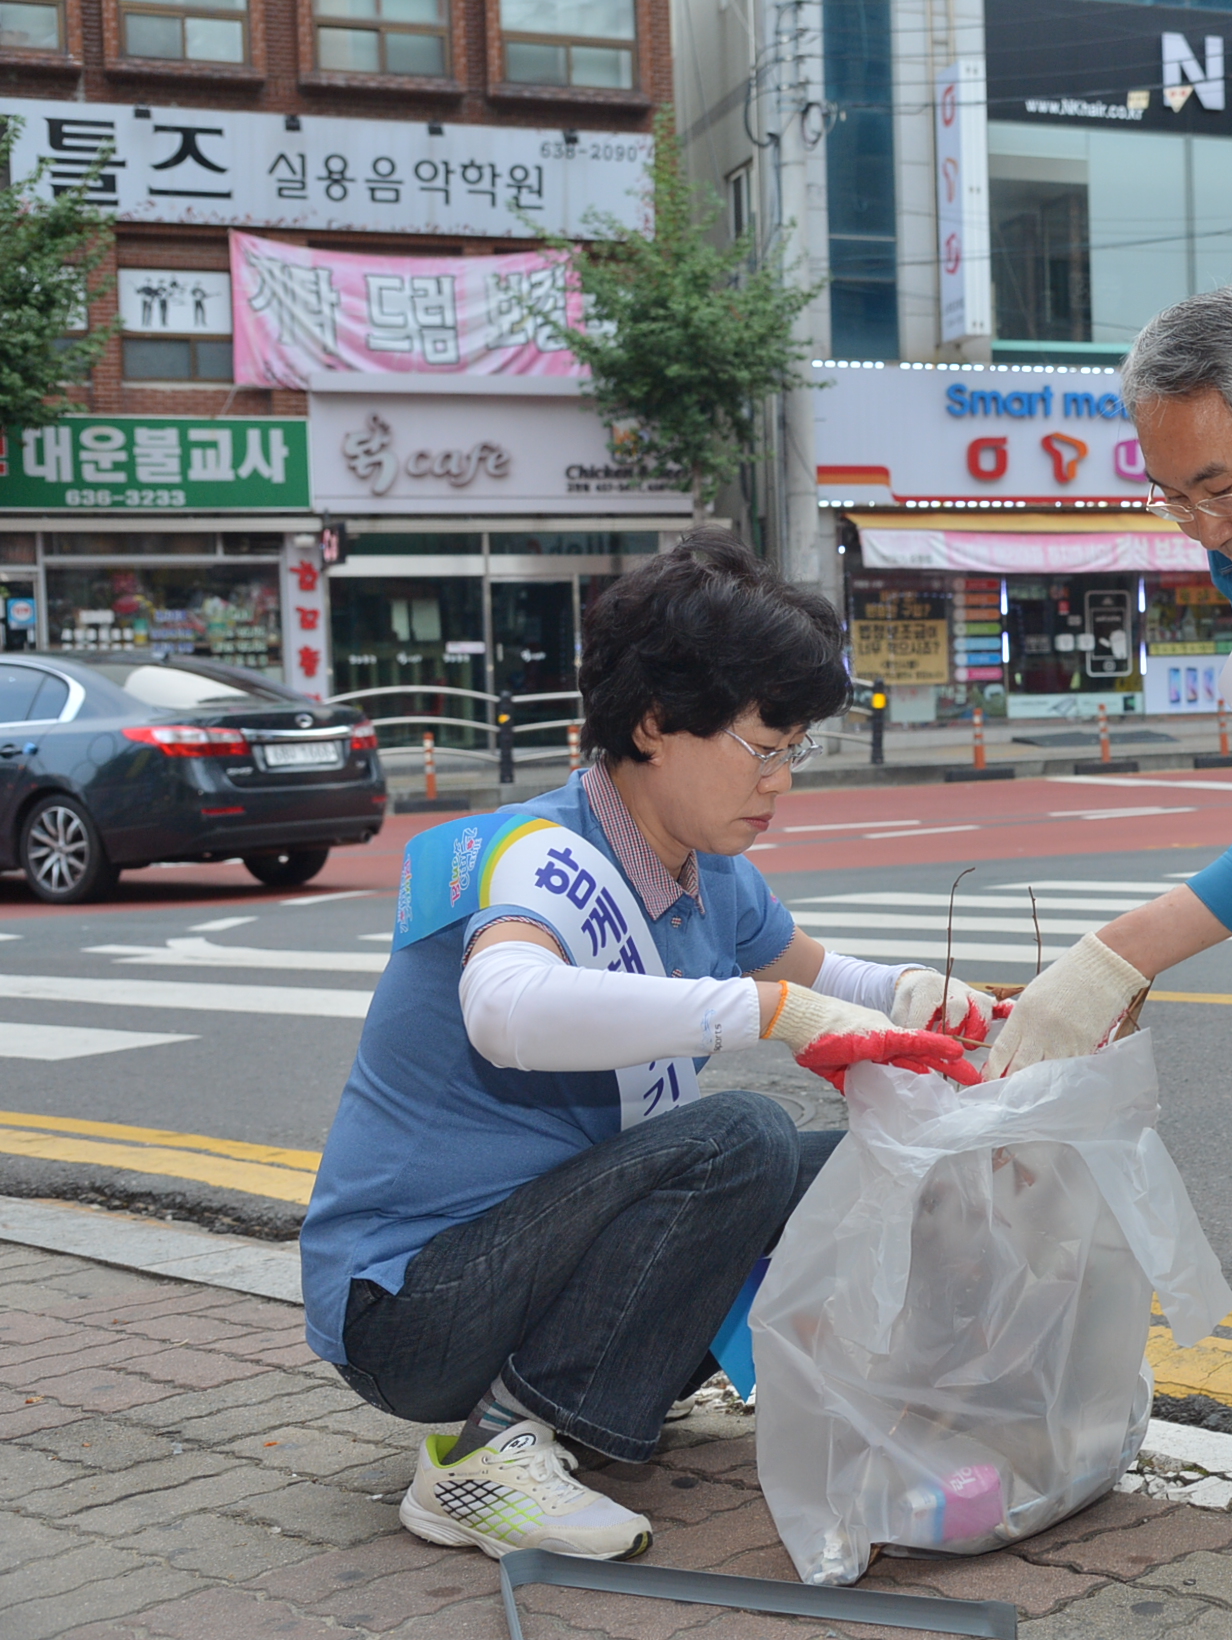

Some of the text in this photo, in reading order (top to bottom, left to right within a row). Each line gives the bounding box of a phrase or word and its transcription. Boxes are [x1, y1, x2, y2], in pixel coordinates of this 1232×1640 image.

[268, 152, 544, 212] 실용음악학원
[946, 384, 1052, 417] Smart
[21, 425, 290, 484] 대운불교사
[405, 442, 509, 488] cafe
